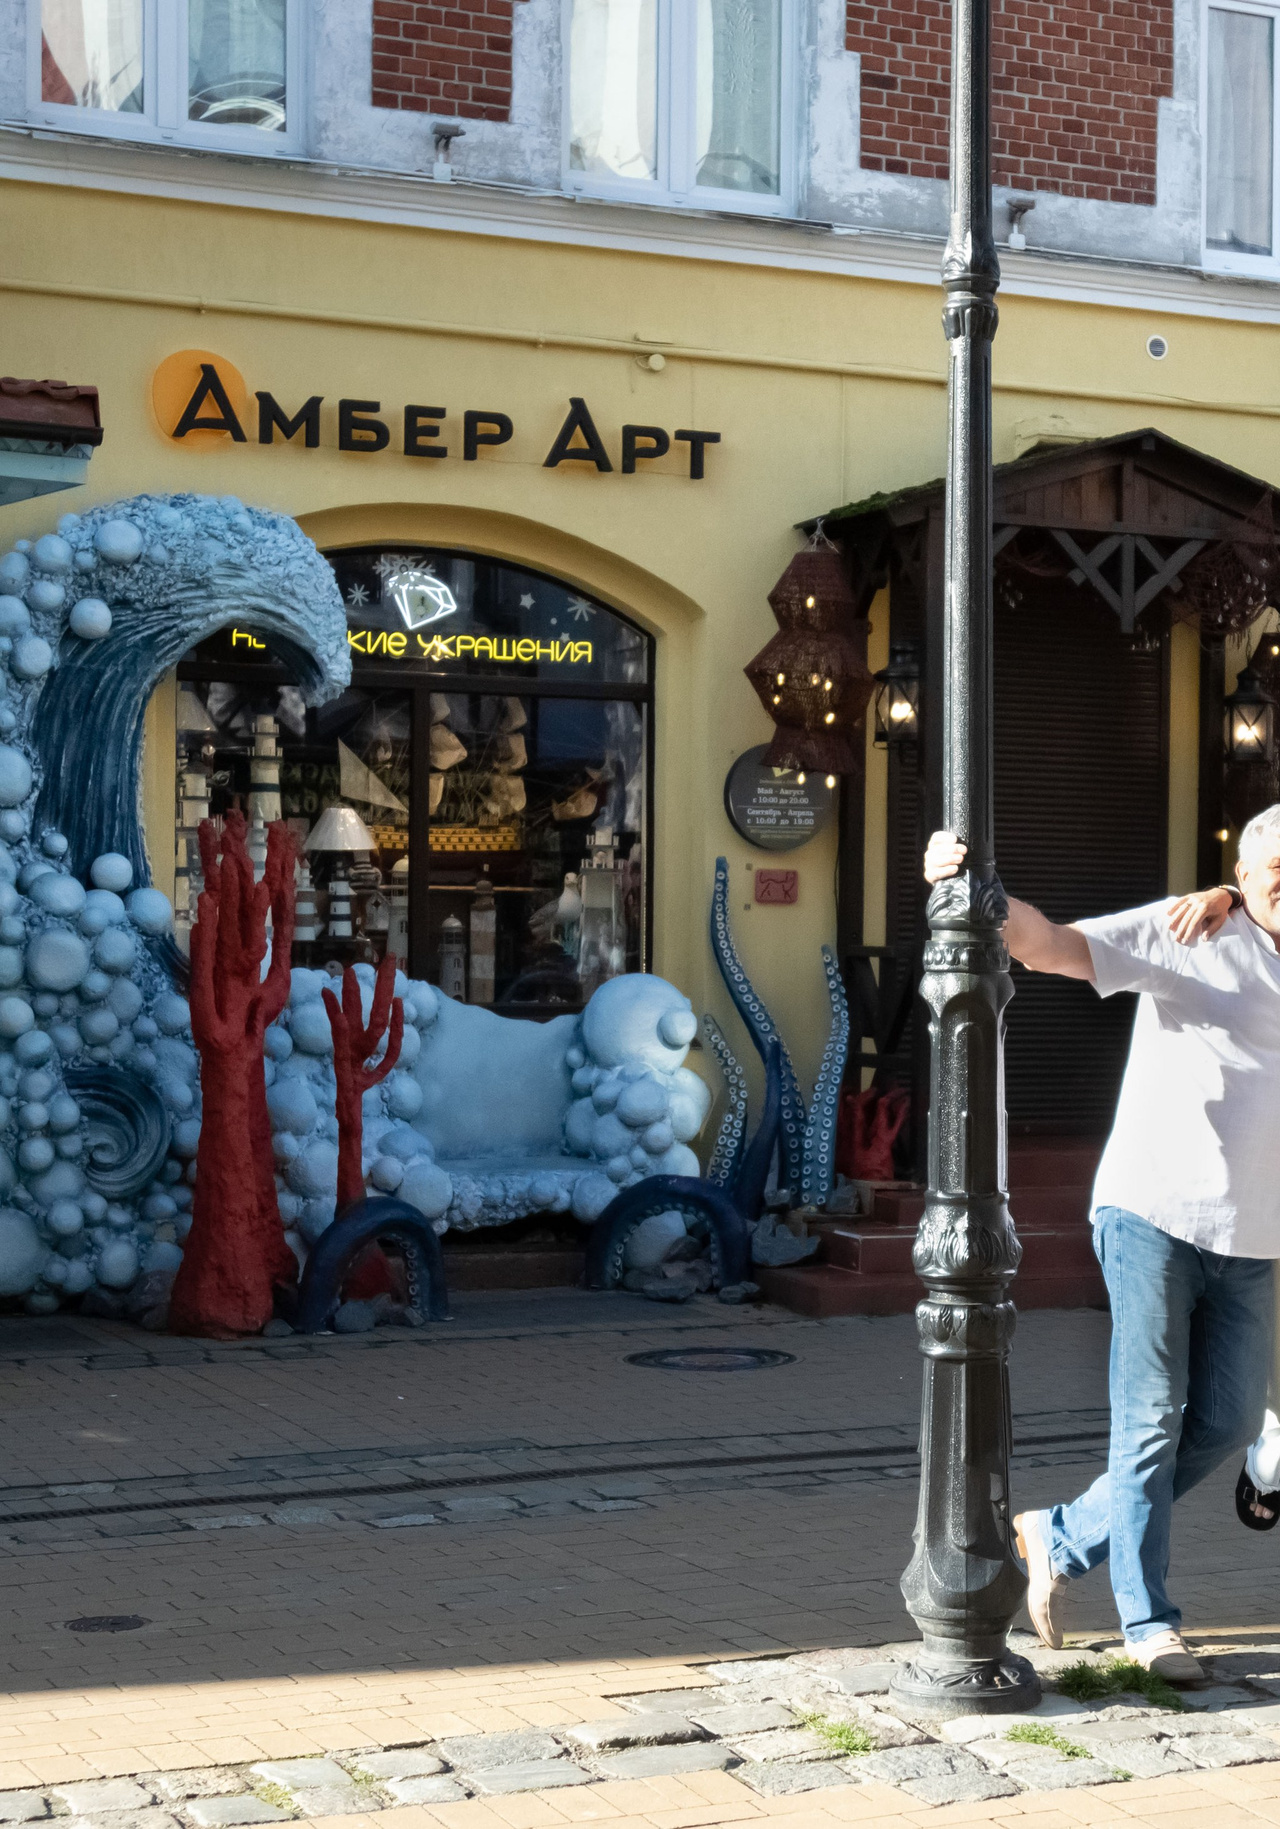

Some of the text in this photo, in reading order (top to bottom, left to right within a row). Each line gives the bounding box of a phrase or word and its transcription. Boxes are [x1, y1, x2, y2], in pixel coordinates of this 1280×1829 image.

[172, 363, 722, 480] АМБЕР АРТ
[757, 787, 774, 795] Май
[779, 787, 805, 797] Август
